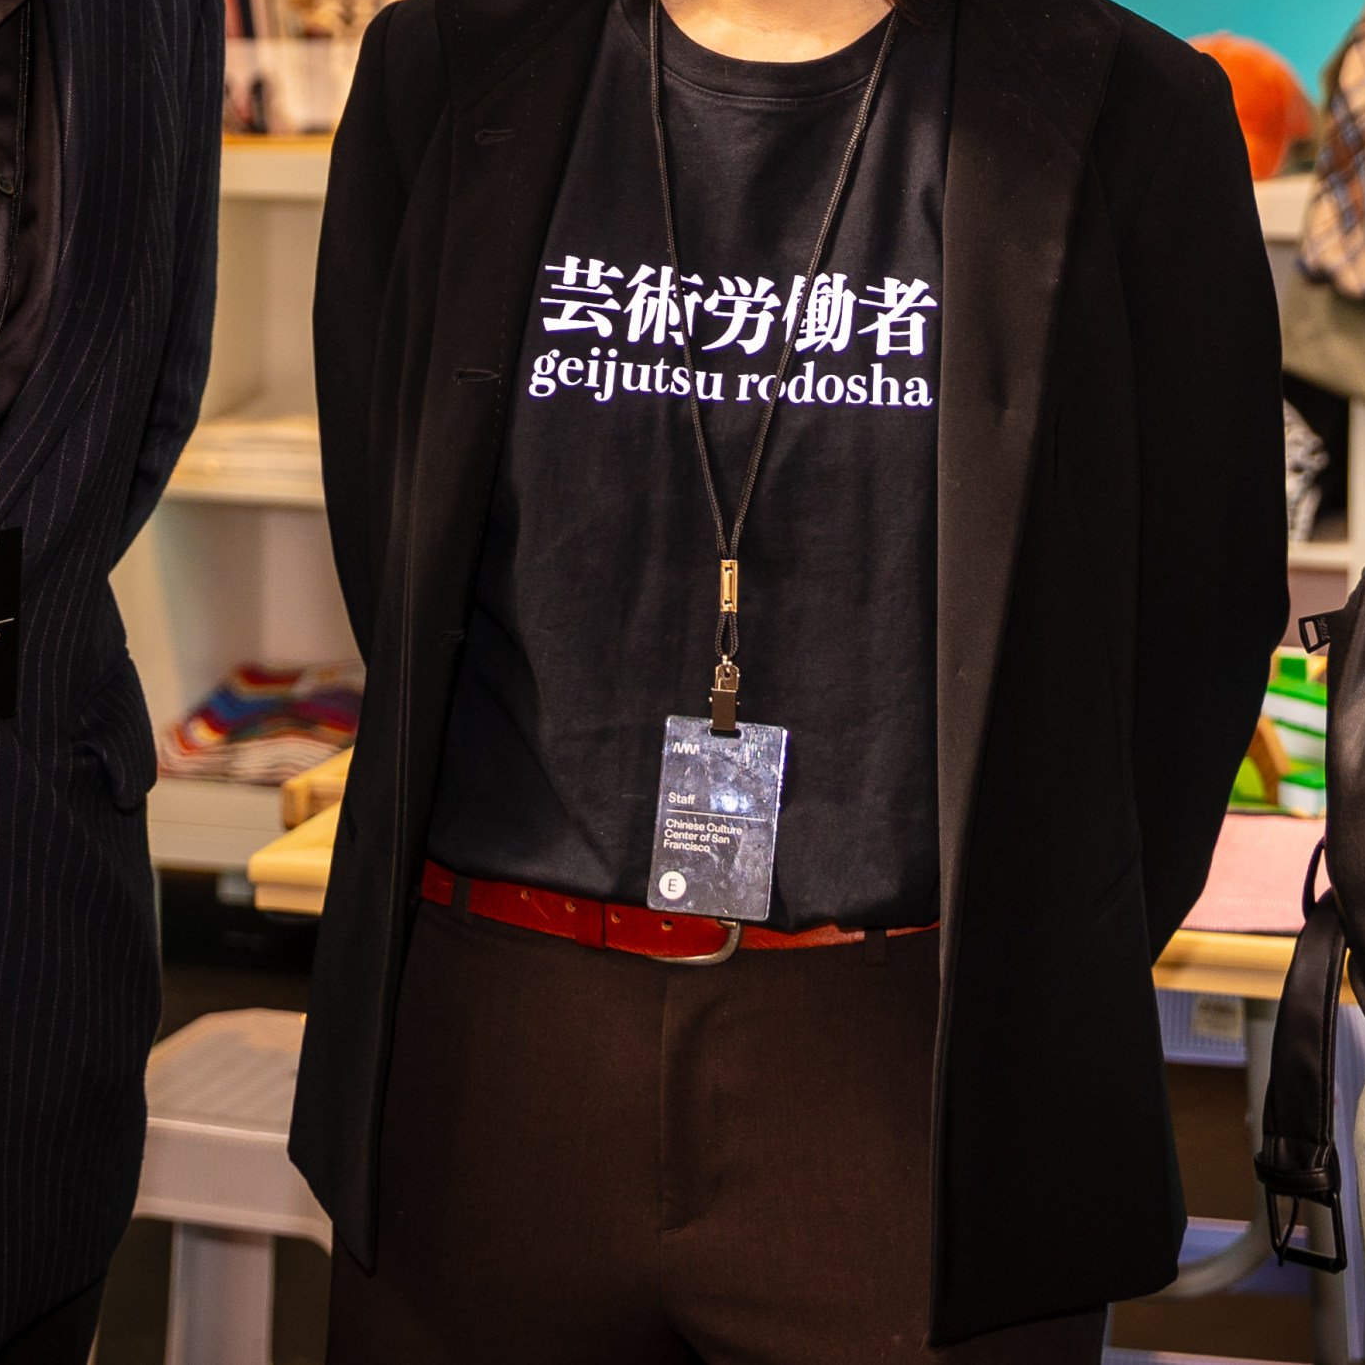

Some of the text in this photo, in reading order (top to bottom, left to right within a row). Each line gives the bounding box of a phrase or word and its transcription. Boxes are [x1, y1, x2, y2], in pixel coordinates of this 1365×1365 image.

[540, 255, 938, 356] 芸術労働者
[529, 346, 933, 407] geijutsu rodosha
[668, 792, 696, 806] Staff
[665, 818, 743, 835] Chinese Culture
[664, 829, 730, 845] Center of San
[663, 840, 711, 853] Francisco
[668, 879, 678, 892] E
